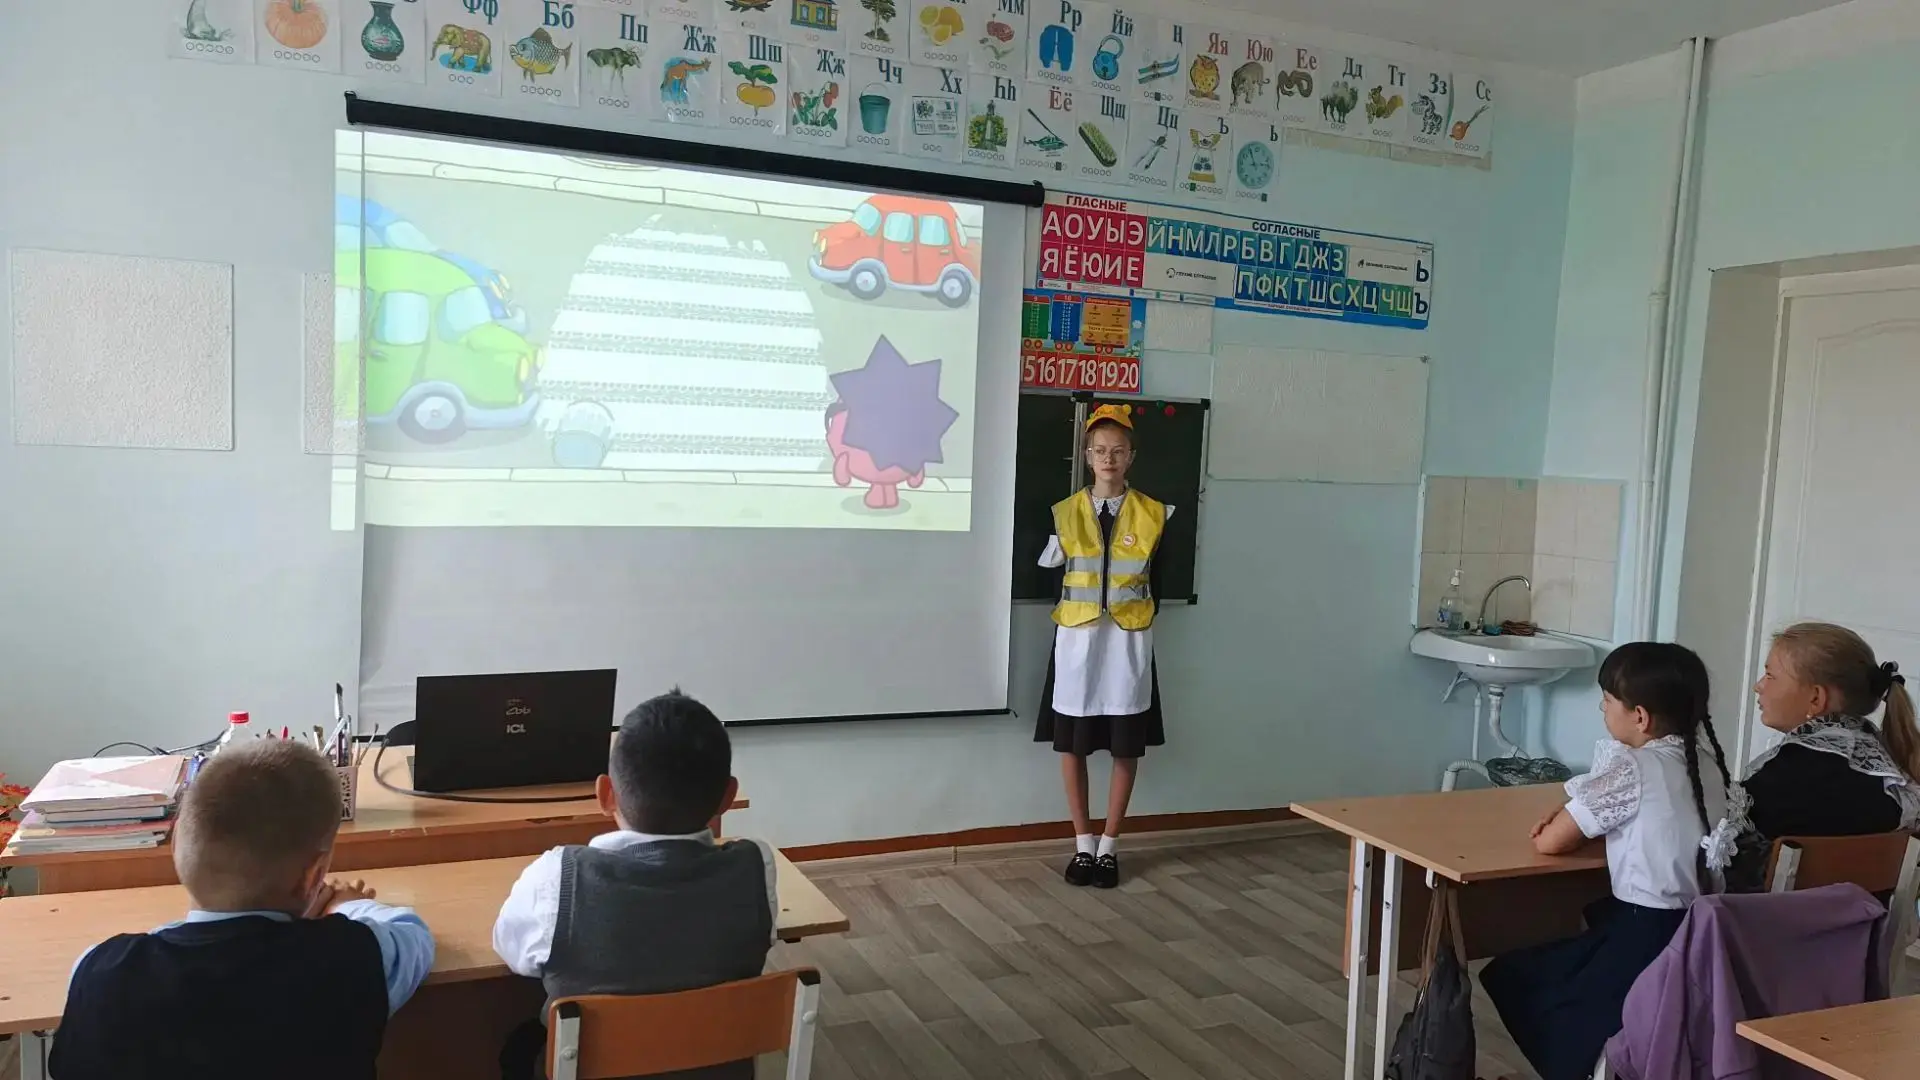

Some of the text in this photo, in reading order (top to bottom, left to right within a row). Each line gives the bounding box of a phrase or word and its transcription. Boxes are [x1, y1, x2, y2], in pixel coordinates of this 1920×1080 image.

[543, 1, 575, 29] Бб
[1060, 0, 1083, 32] Рр
[1111, 9, 1134, 37] Йй
[619, 13, 649, 44] Пп
[683, 24, 717, 53] Жж
[749, 34, 783, 63] Шш
[1208, 32, 1229, 56] Яя
[1246, 39, 1273, 64] Юю
[877, 57, 903, 84] Чч
[1296, 49, 1318, 70] Ее
[1342, 57, 1364, 80] Дд
[940, 68, 963, 95] Хх
[1387, 65, 1407, 87] Тт
[1428, 73, 1448, 95] Зз
[1049, 86, 1073, 112] Ёё
[1476, 80, 1493, 102] Сс
[1101, 95, 1126, 120] Щщ
[1157, 106, 1179, 131] Цц
[1066, 195, 1127, 212] ГЛАСНЫЕ
[1252, 221, 1321, 240] СОГЛАСНЫЕ
[1038, 356, 1056, 383] 16
[1058, 358, 1078, 385] 17
[1078, 359, 1097, 386] 18
[1098, 361, 1118, 387] 19
[1118, 362, 1138, 388] 20
